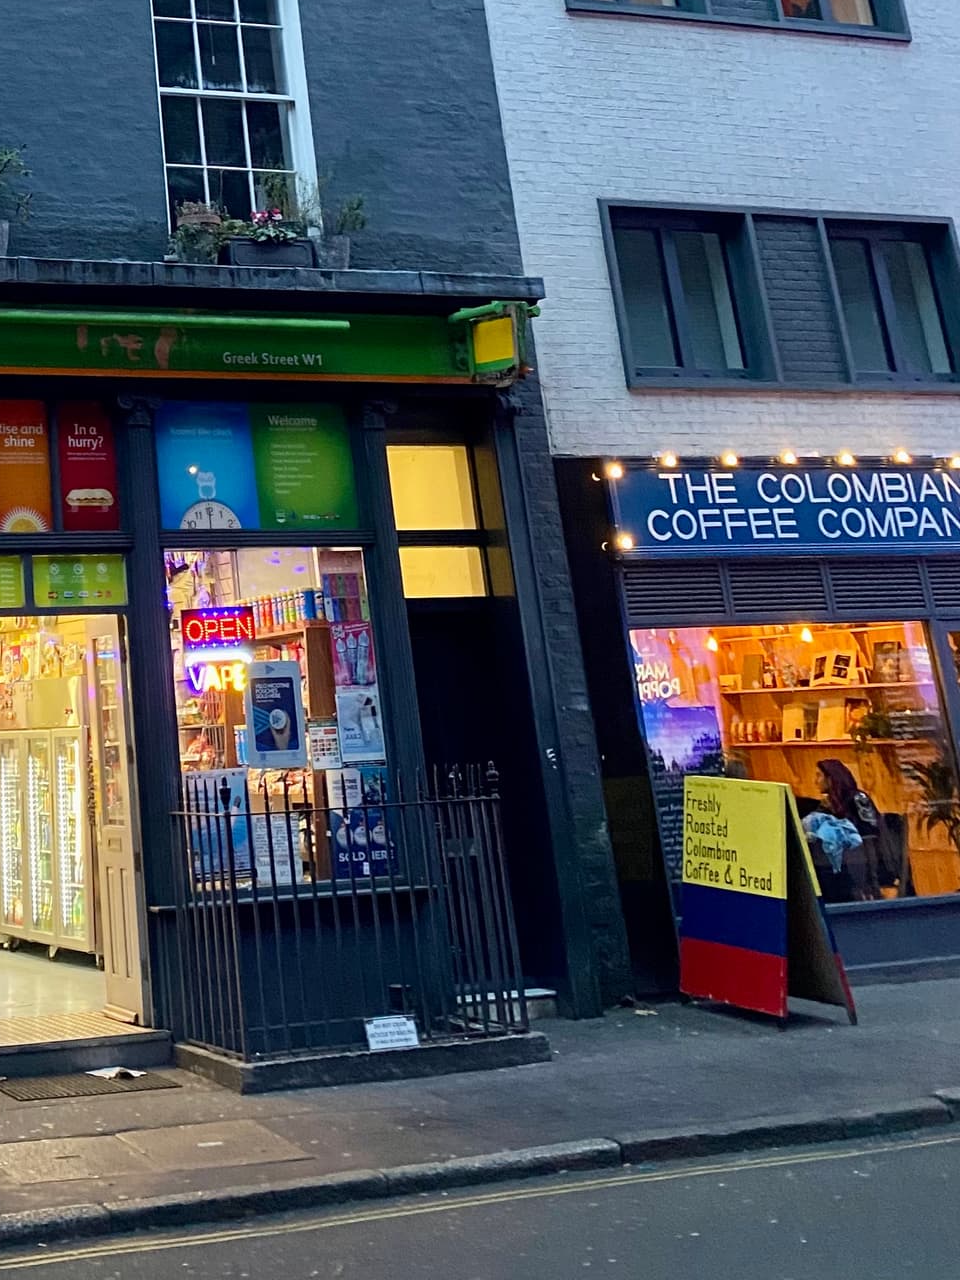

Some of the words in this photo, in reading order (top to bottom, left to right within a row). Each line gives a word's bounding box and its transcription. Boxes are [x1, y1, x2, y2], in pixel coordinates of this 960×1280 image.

[223, 351, 260, 366] Greek
[262, 353, 300, 367] Street
[302, 354, 323, 368] W1
[20, 423, 44, 435] and
[74, 424, 87, 435] In
[89, 426, 97, 435] a
[268, 415, 317, 426] Welcome
[4, 436, 35, 447] shine
[68, 436, 104, 450] hurry?
[659, 473, 738, 504] THE
[757, 473, 960, 504] COLOMBIAN
[195, 512, 202, 520] 11
[647, 508, 799, 541] COFFEE
[186, 617, 252, 641] OPEN
[188, 664, 248, 691] VAPE
[686, 791, 721, 817] Freshly
[686, 814, 728, 838] Roasted
[686, 837, 738, 863] Colombian
[685, 861, 720, 883] Coffee
[724, 865, 734, 885] &
[739, 868, 773, 891] Bread
